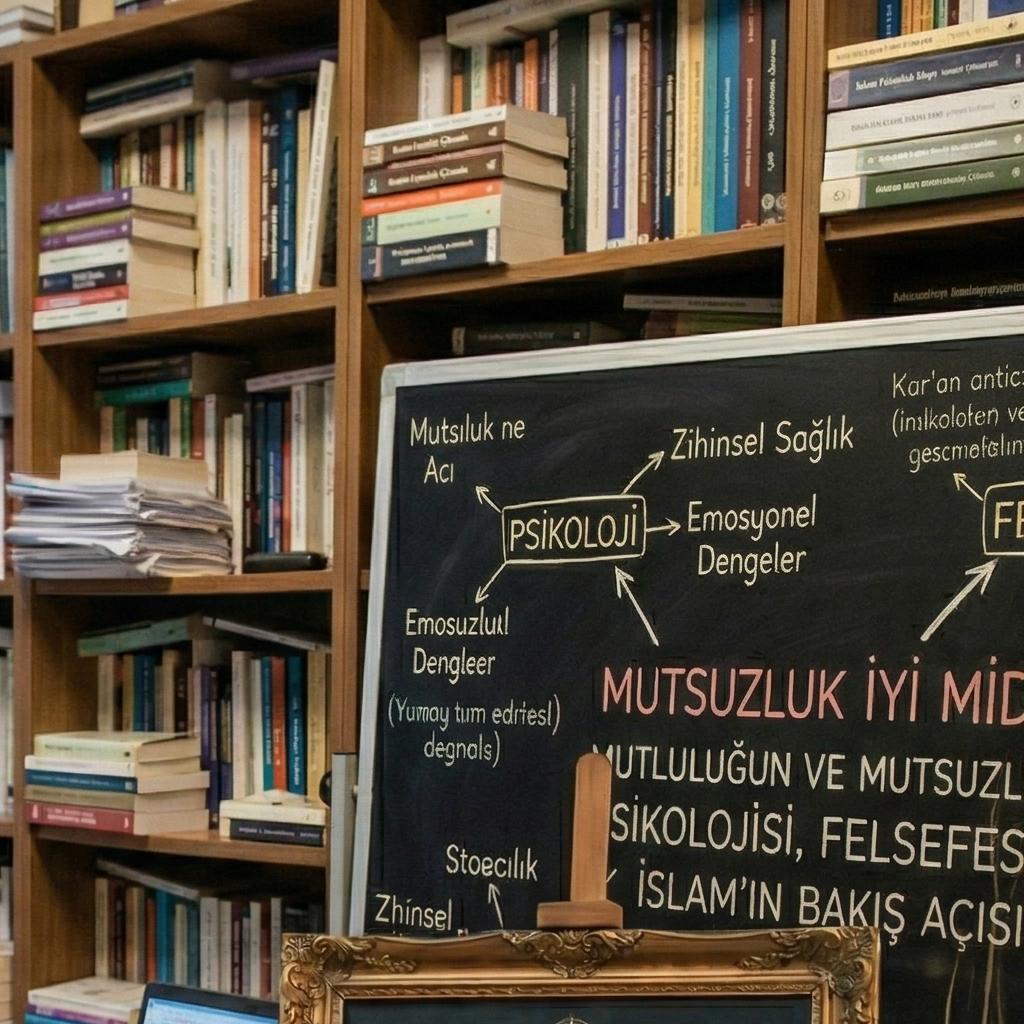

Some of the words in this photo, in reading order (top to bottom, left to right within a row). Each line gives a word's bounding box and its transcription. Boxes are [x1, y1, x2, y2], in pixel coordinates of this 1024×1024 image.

[970, 364, 1024, 391] antic
[502, 419, 525, 440] ne
[670, 421, 765, 460] Zihinsel
[775, 414, 854, 464] Sağlık
[510, 503, 637, 551] PSİKOLOJİ
[687, 493, 817, 542] Emosyonel
[697, 541, 807, 587] Dengeler
[412, 646, 496, 685] Dengleer
[602, 665, 848, 721] MUTSUZLUK
[865, 655, 920, 723] İYİ
[803, 752, 846, 791] VE
[859, 755, 1024, 801] MUTSUZL
[610, 795, 804, 863] SİKOLOJİSİ,
[820, 816, 1024, 874] FELSEFES
[798, 885, 907, 945] BAKIŞ
